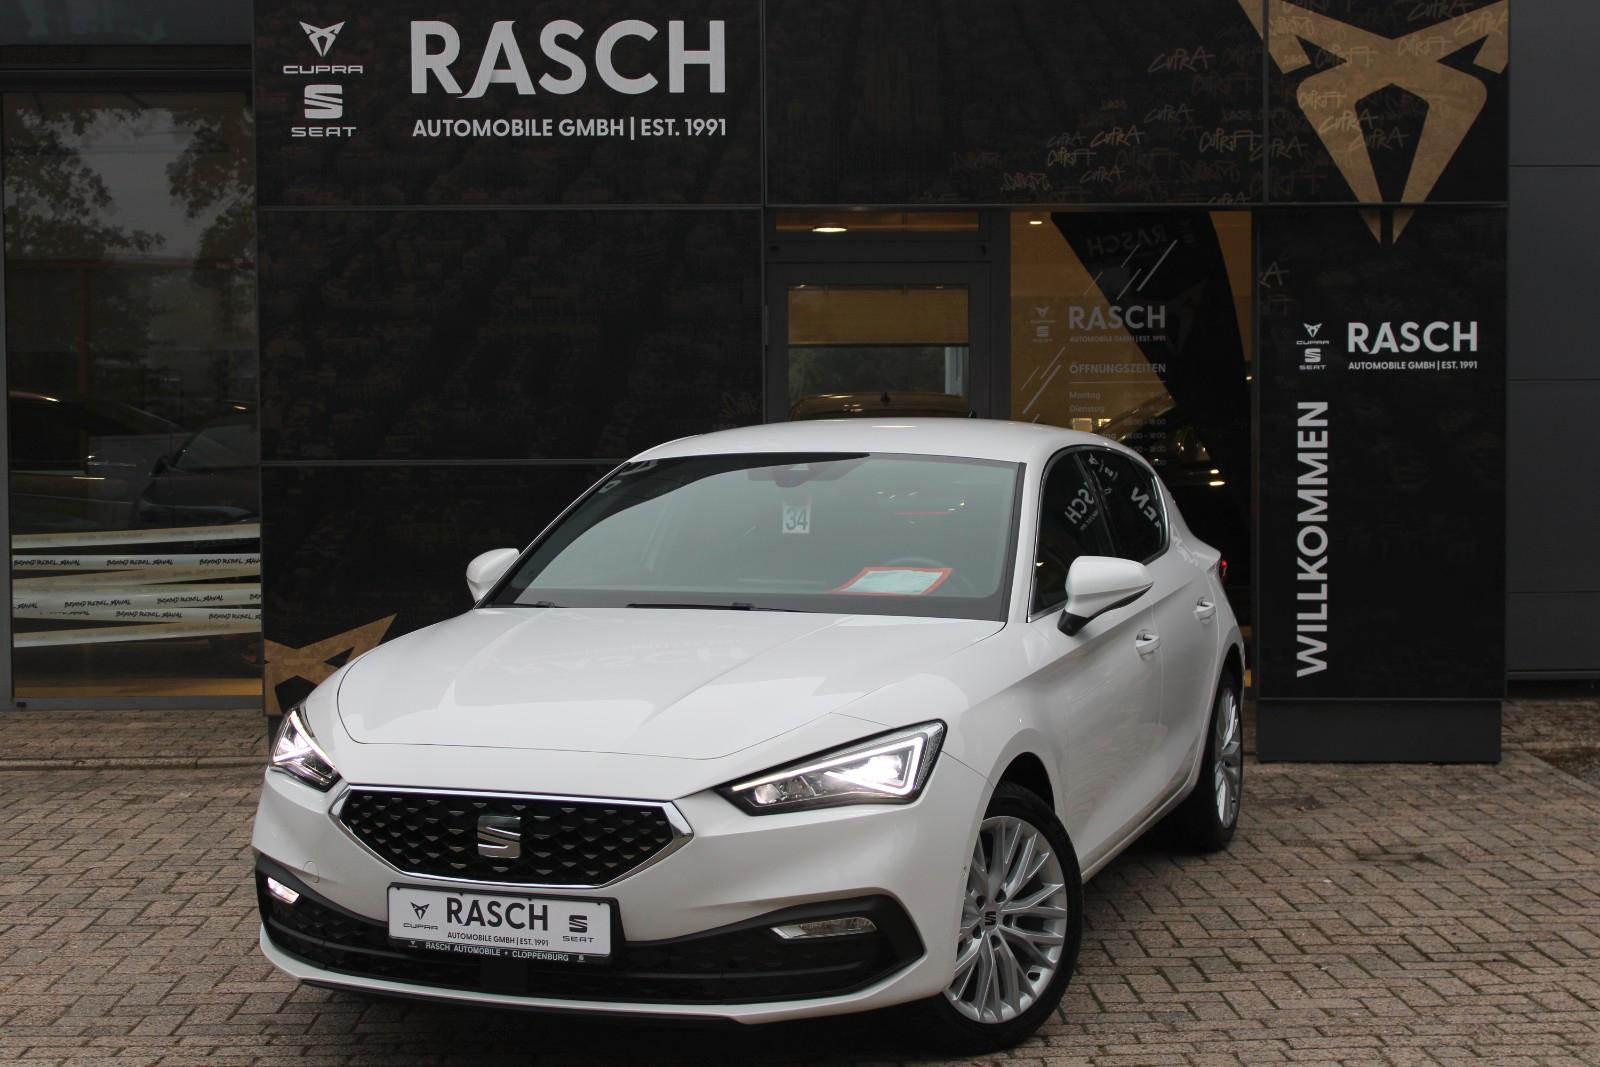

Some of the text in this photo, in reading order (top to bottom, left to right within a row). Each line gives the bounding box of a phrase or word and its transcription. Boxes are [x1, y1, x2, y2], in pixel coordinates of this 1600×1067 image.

[283, 65, 363, 73] CUPRA
[411, 20, 725, 98] RASCH
[292, 127, 356, 136] SEAT
[413, 119, 725, 136] AUTOMOBILE GMBH EST. 1991
[1069, 305, 1166, 330] RASCH
[1348, 321, 1477, 354] RASCH
[1070, 362, 1166, 374] ÖFFNUNGSZEITEN
[1442, 361, 1458, 369] EST.
[785, 508, 808, 530] 34
[1297, 402, 1328, 677] WILLKOMMEN
[447, 897, 549, 931] RASCH
[448, 932, 549, 947] AUTOMOBILE GMBH EST. 1991
[426, 942, 569, 962] RASCH AUTOMOBILE CLOPPENBURG
